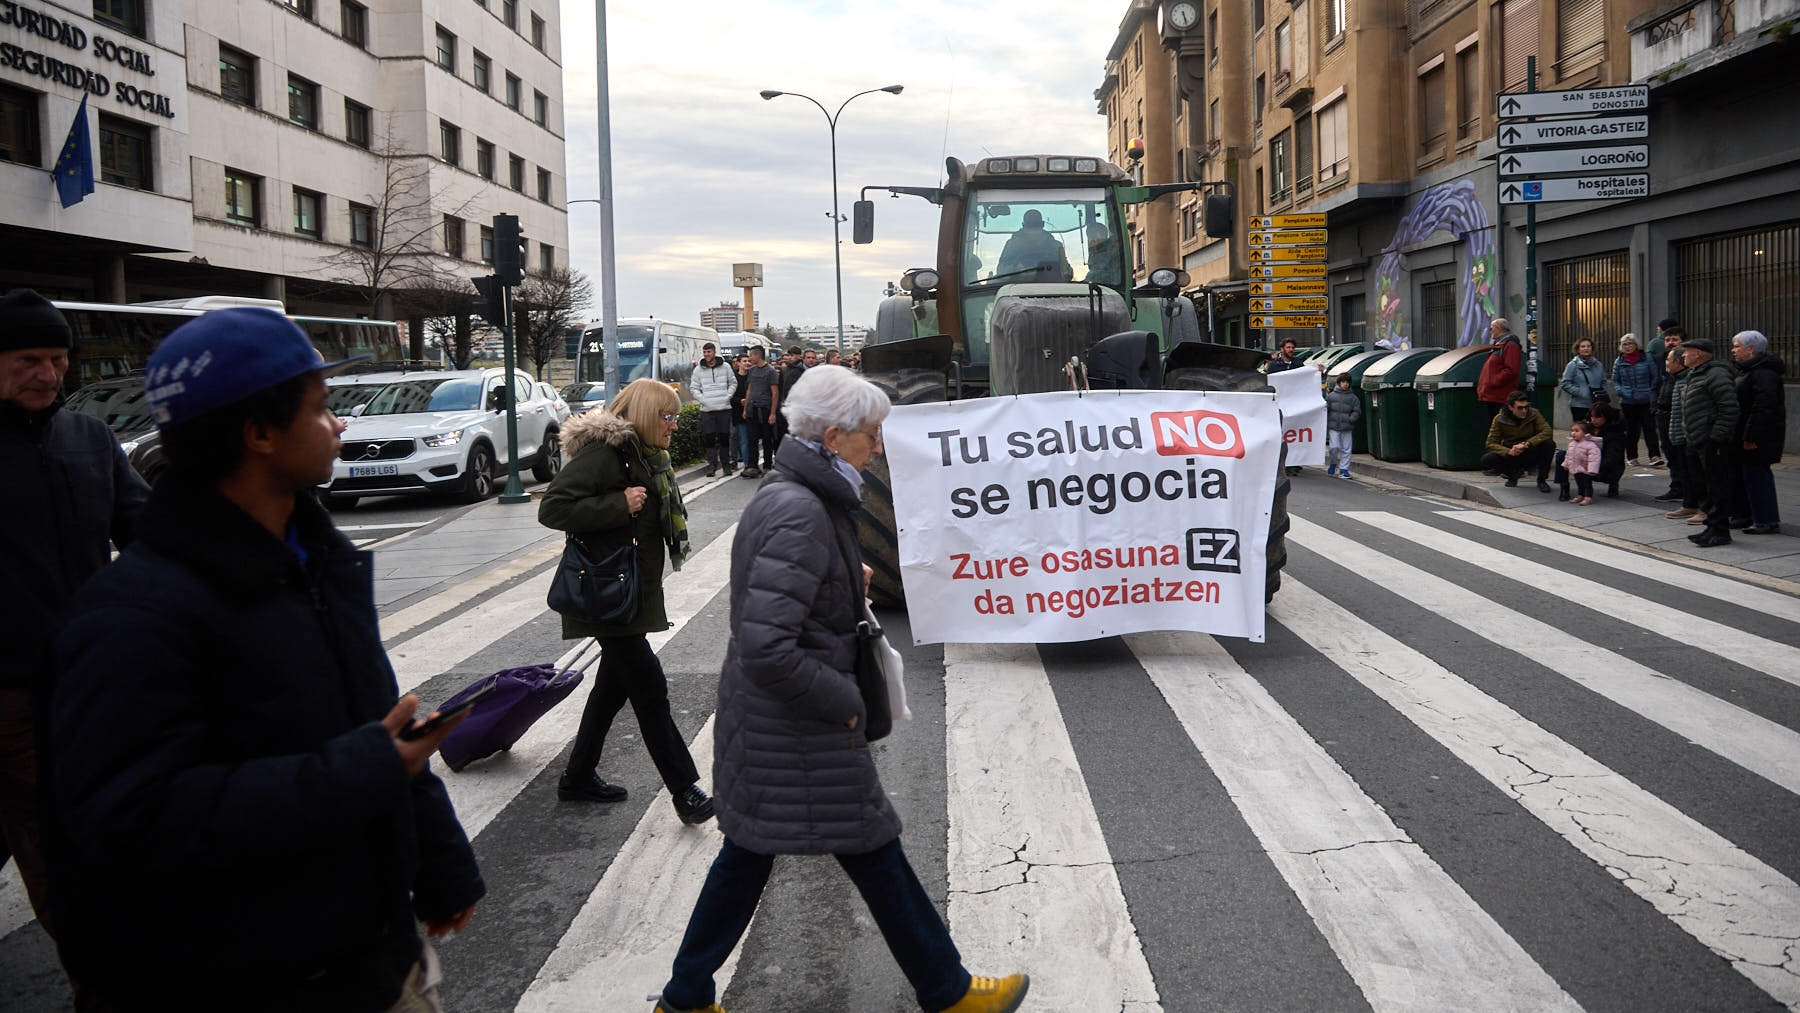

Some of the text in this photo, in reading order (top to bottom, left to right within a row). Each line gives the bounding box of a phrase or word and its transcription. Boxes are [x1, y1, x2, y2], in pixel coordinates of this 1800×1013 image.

[93, 35, 155, 77] SOCIAL
[0, 42, 175, 118] SEGURIDAD SOCIAL
[1562, 88, 1646, 102] SAN SEBASTIÁN
[1592, 99, 1646, 110] DONOSTIA
[1537, 121, 1646, 138] VITORIA-GASTEIZ
[1581, 150, 1646, 166] LOGROÑO
[1578, 177, 1645, 192] hospitales
[1597, 187, 1646, 198] ospitaleak
[928, 415, 1236, 467] Tu salud NO
[353, 465, 396, 477] 7689 LGS
[950, 457, 1228, 519] se negocia
[950, 533, 1239, 581] Zure osasuna EZ
[974, 577, 1221, 619] da negoziatzen
